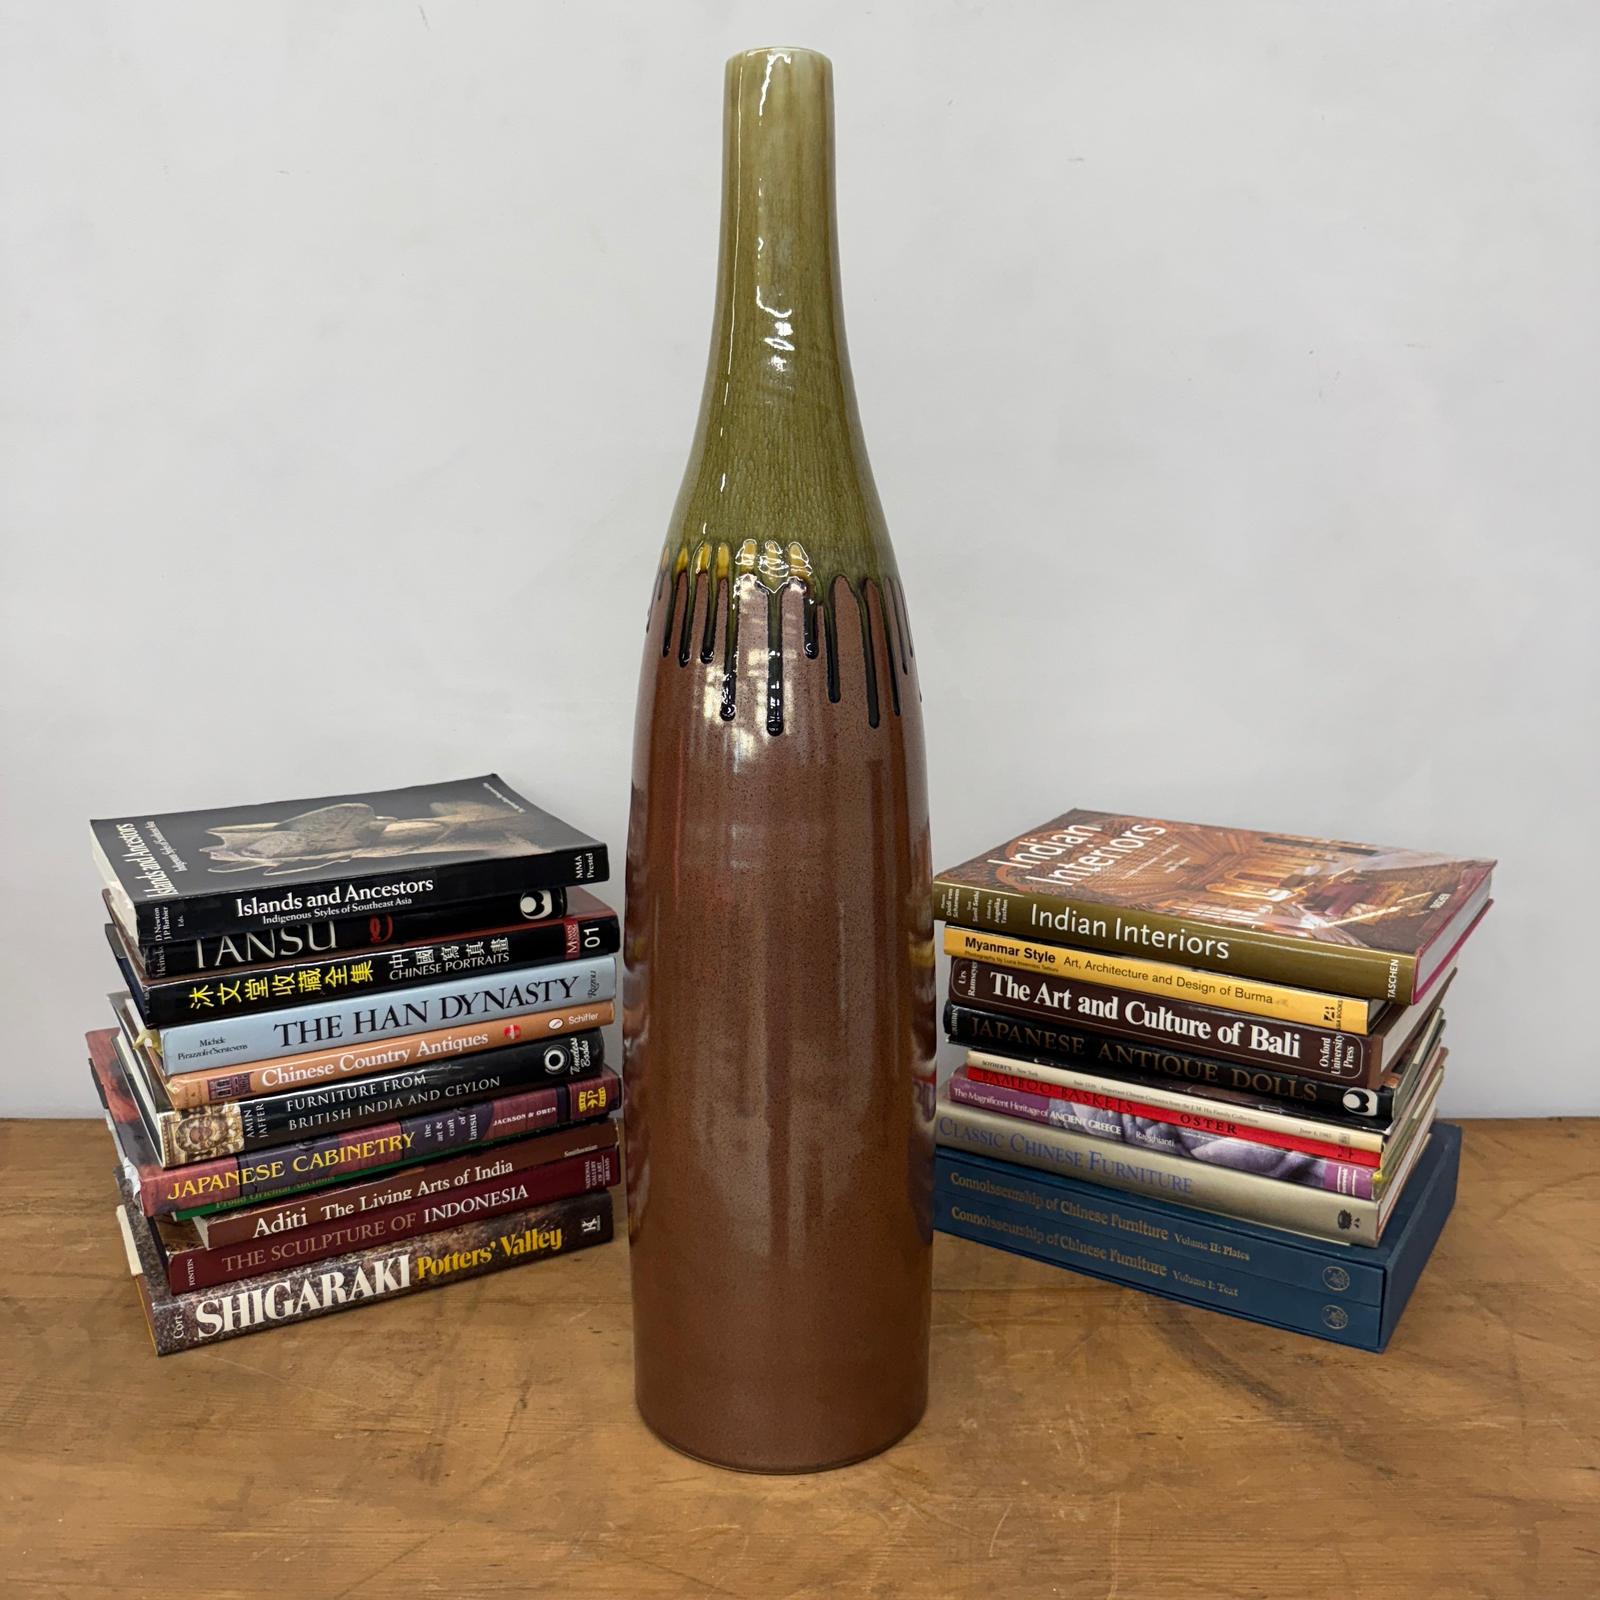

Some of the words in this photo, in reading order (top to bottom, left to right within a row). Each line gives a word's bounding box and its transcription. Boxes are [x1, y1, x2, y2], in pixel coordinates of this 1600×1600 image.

[586, 852, 595, 879] Prestel
[987, 824, 1102, 869] Indian
[1025, 824, 1166, 886] Interiors
[575, 855, 583, 880] MMA
[236, 892, 303, 917] Islands
[306, 885, 341, 906] and
[345, 879, 434, 902] Ancestors
[262, 911, 312, 925] Indigenous
[314, 908, 339, 919] Styles
[341, 905, 350, 914] of
[352, 899, 394, 913] Southeast
[395, 897, 412, 906] Asia
[583, 927, 601, 948] 01
[1031, 904, 1106, 938] Indian
[1115, 917, 1230, 960] Interiors
[188, 959, 374, 1010] 沐文堂收藏全集
[389, 963, 442, 981] CHINESE
[445, 952, 510, 972] PORTRAITS
[965, 936, 1020, 957] Myanmar
[1023, 947, 1056, 964] Style
[1063, 956, 1082, 970] Art,
[1085, 960, 1149, 981] Architecture
[1152, 972, 1173, 985] and
[1176, 977, 1216, 995] Design
[1219, 985, 1231, 996] of
[1235, 988, 1273, 1004] Burma
[968, 961, 978, 997] Ramseyer
[1387, 958, 1399, 1000] TASCHEN
[273, 1014, 344, 1048] THE
[353, 999, 430, 1035] HAN
[439, 975, 580, 1020] DYNASTY
[568, 1012, 599, 1025] Schiffer
[989, 971, 1031, 1001] The
[1034, 982, 1072, 1011] Art
[1077, 996, 1119, 1021] and
[1124, 1000, 1212, 1040] Culture
[1217, 1021, 1244, 1046] of
[1248, 1024, 1301, 1059] Bali
[261, 1063, 335, 1088] Chinese
[339, 1046, 411, 1072] Country
[416, 1033, 489, 1058] Antiques
[579, 1040, 591, 1068] Books
[970, 1016, 1086, 1055] JAPANESE
[1097, 1041, 1219, 1082] ANTIQUE
[1231, 1068, 1318, 1102] DOLLS
[1319, 1037, 1331, 1068] Oxford
[1330, 1034, 1344, 1075] University
[1343, 1046, 1354, 1069] Press
[286, 1080, 382, 1112] FURNITURE
[383, 1074, 427, 1092] FROM
[288, 1105, 351, 1131] BRITISH
[358, 1096, 403, 1116] INDIA
[407, 1088, 441, 1106] AND
[445, 1076, 500, 1097] CEYLON
[954, 1088, 968, 1099] The
[968, 1090, 1009, 1110] Magnificent
[1009, 1101, 1040, 1117] Heritage
[1040, 1107, 1050, 1117] of
[1049, 1110, 1087, 1127] ANCIENT
[1087, 1119, 1122, 1135] GREECE
[1061, 1086, 1134, 1113] BASKETS
[1180, 1114, 1238, 1135] OSTER
[243, 1109, 255, 1138] AMIN
[256, 1103, 269, 1138] JAFFER
[436, 1131, 444, 1142] art
[446, 1118, 455, 1137] craft
[458, 1116, 466, 1125] of
[493, 1113, 526, 1127] JACKSON
[536, 1107, 557, 1116] OWEN
[167, 1161, 286, 1200] JAPANESE
[292, 1132, 415, 1173] CABINETRY
[938, 1116, 1004, 1148] CLASSIC
[1009, 1132, 1083, 1169] CHINESE
[1088, 1150, 1193, 1194] FURNITURE
[252, 1206, 309, 1239] Aditi
[320, 1202, 354, 1221] The
[359, 1186, 413, 1214] Living
[417, 1178, 451, 1197] Arts
[453, 1170, 471, 1187] of
[474, 1160, 513, 1182] India
[950, 1172, 1043, 1210] Connoisseurship
[1045, 1198, 1059, 1211] of
[1059, 1200, 1108, 1225] Chinese
[1111, 1214, 1169, 1240] Furniture
[1174, 1232, 1208, 1250] Volume
[1210, 1242, 1222, 1254] II:
[1222, 1245, 1250, 1261] Plates
[222, 1249, 266, 1273] THE
[271, 1222, 386, 1261] SCULPTURE
[390, 1213, 416, 1231] OF
[424, 1184, 529, 1224] INDONESIA
[950, 1206, 1046, 1245] Connoisseurship
[1046, 1232, 1060, 1247] of
[1060, 1235, 1105, 1260] Chinese
[1109, 1248, 1168, 1277] Furniture
[1172, 1269, 1207, 1288] Volume
[1217, 1281, 1239, 1297] Text
[195, 1254, 411, 1338] SHIGARAKI
[417, 1241, 497, 1279] Potters'
[500, 1227, 563, 1257] Valley
[173, 1313, 185, 1339] Cort
